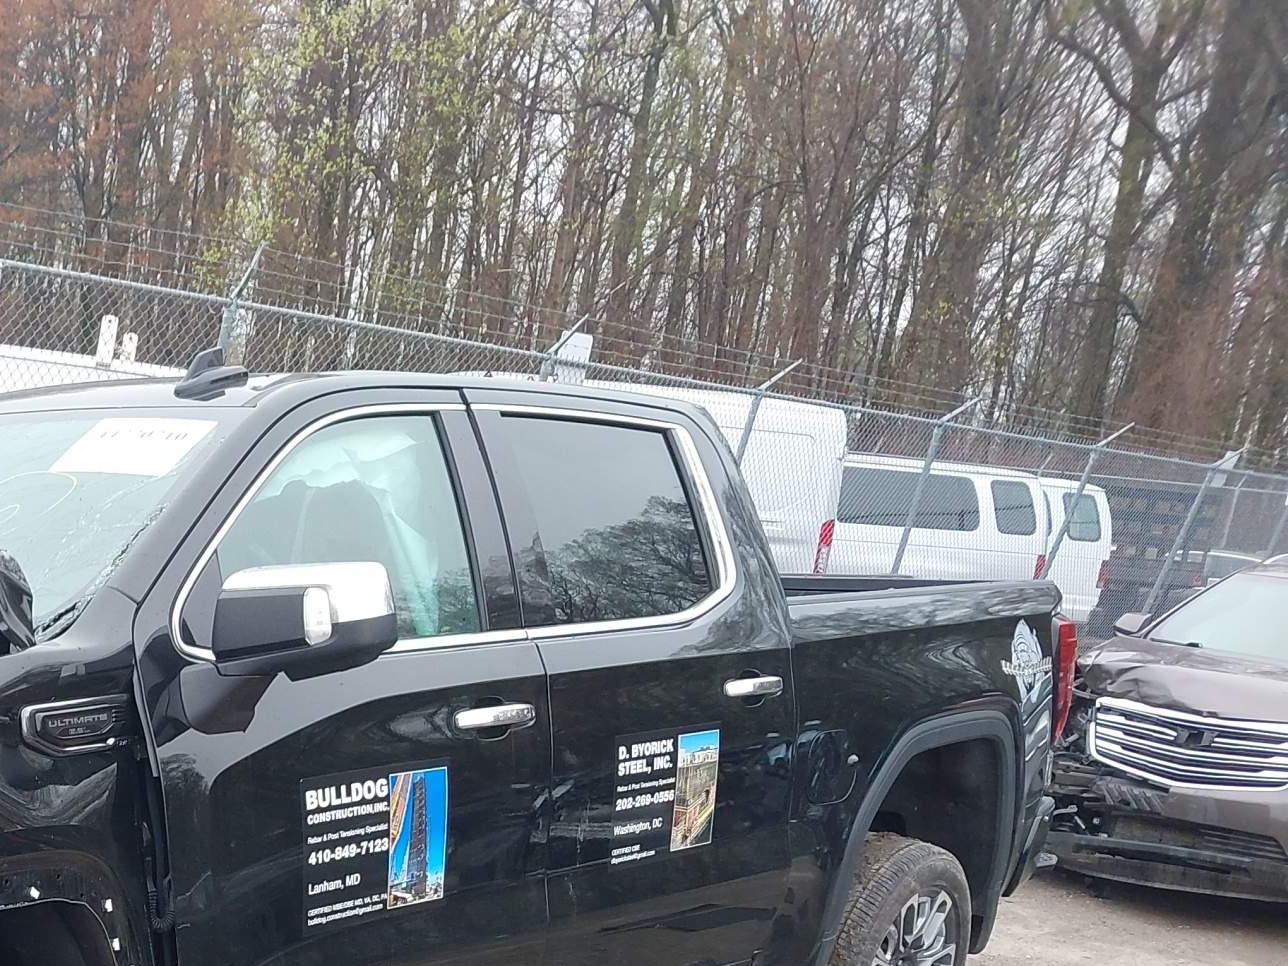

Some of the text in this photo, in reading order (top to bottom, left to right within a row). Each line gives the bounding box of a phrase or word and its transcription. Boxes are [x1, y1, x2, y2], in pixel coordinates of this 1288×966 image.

[48, 713, 108, 728] ULTIMATE
[618, 738, 674, 761] D. BYORICK
[617, 754, 673, 777] STEEL, INC.
[305, 778, 389, 811] BULLDOG
[327, 832, 340, 840] Post
[614, 817, 663, 837] Washington, DC
[308, 837, 390, 866] 410-849-7123
[308, 873, 361, 896] Lanham, MD
